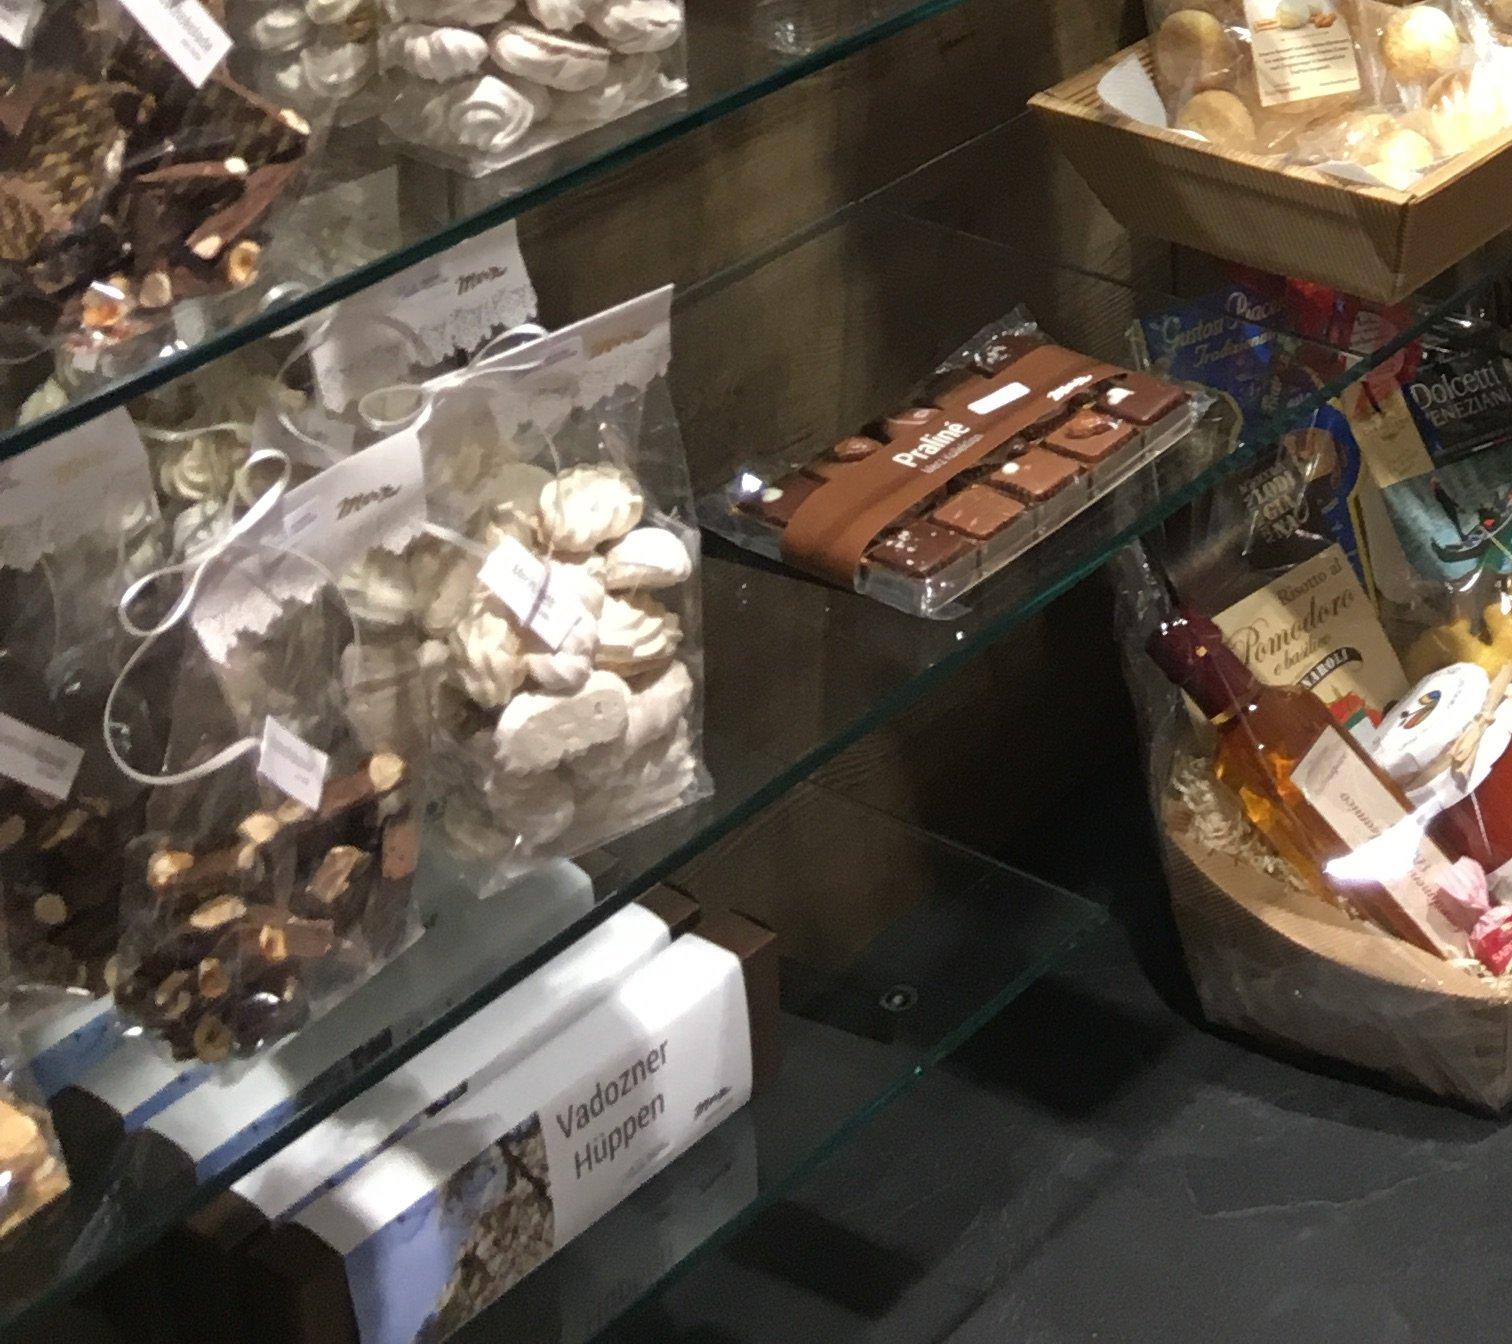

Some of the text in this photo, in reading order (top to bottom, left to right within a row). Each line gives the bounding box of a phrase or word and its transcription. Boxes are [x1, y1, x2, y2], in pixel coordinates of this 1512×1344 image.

[1409, 359, 1502, 410] Dolcetti
[1430, 386, 1512, 427] ENEZIANI
[891, 420, 971, 469] Praliné
[1277, 557, 1342, 607] Risotto al
[1229, 588, 1355, 665] Pomodoro
[1301, 647, 1349, 687] NAROLI
[556, 1038, 669, 1139] Vadozner
[574, 1093, 666, 1180] Hüppen
